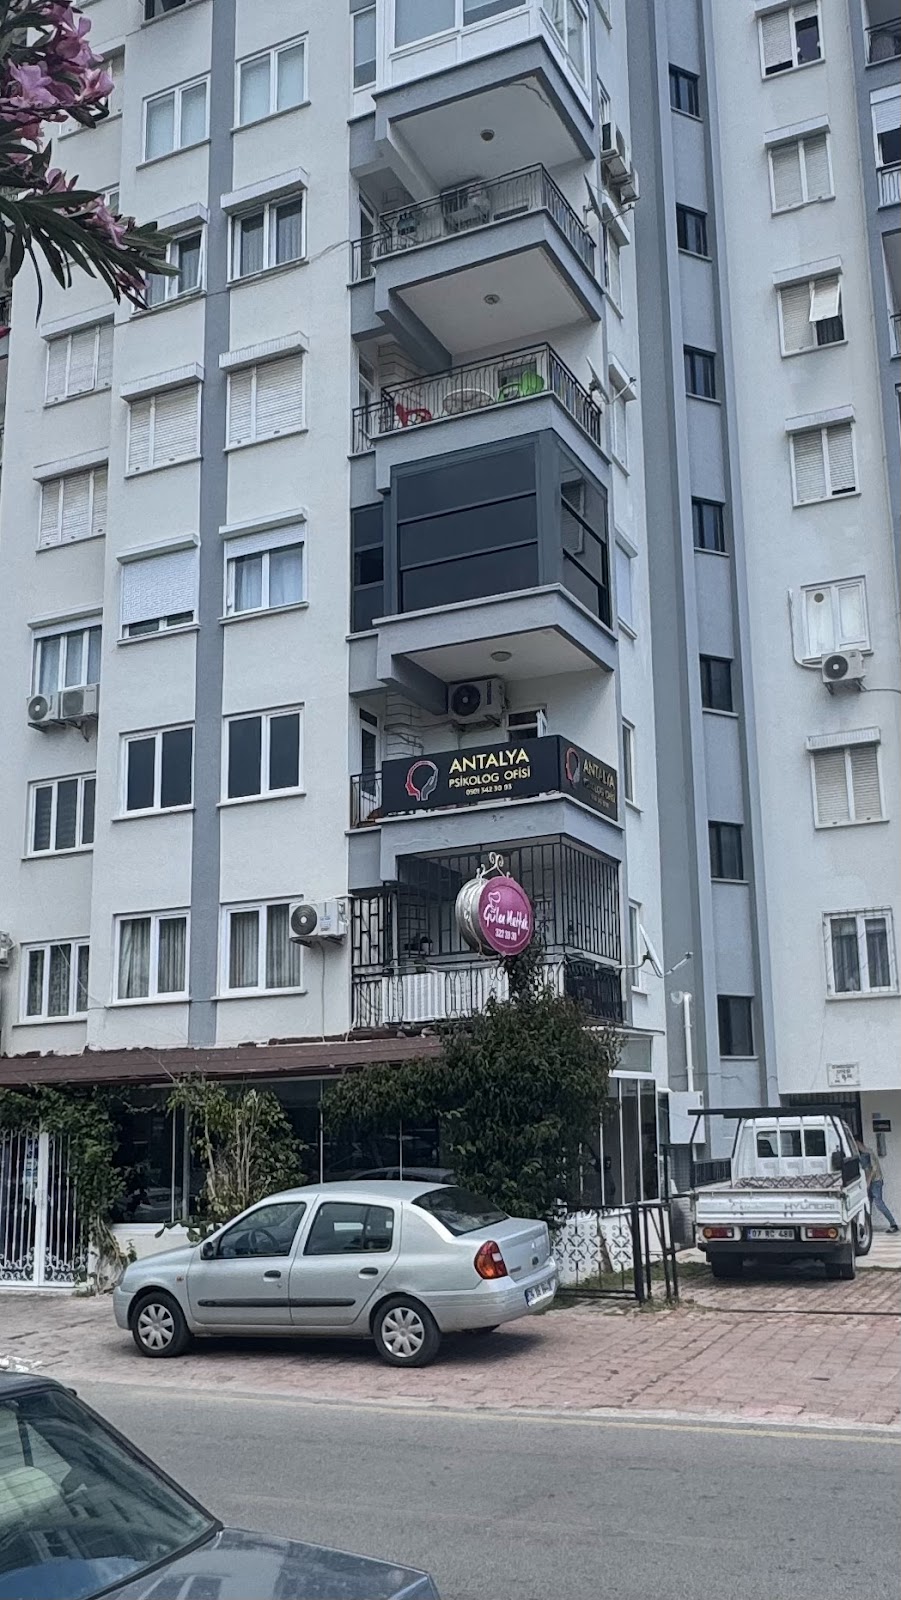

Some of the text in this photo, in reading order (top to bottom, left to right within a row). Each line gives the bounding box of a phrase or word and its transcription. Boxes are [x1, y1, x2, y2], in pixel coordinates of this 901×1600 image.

[449, 748, 530, 774] ANTALYA
[448, 765, 531, 788] PSİKOLOG OFİSİ
[752, 1229, 762, 1238] 07
